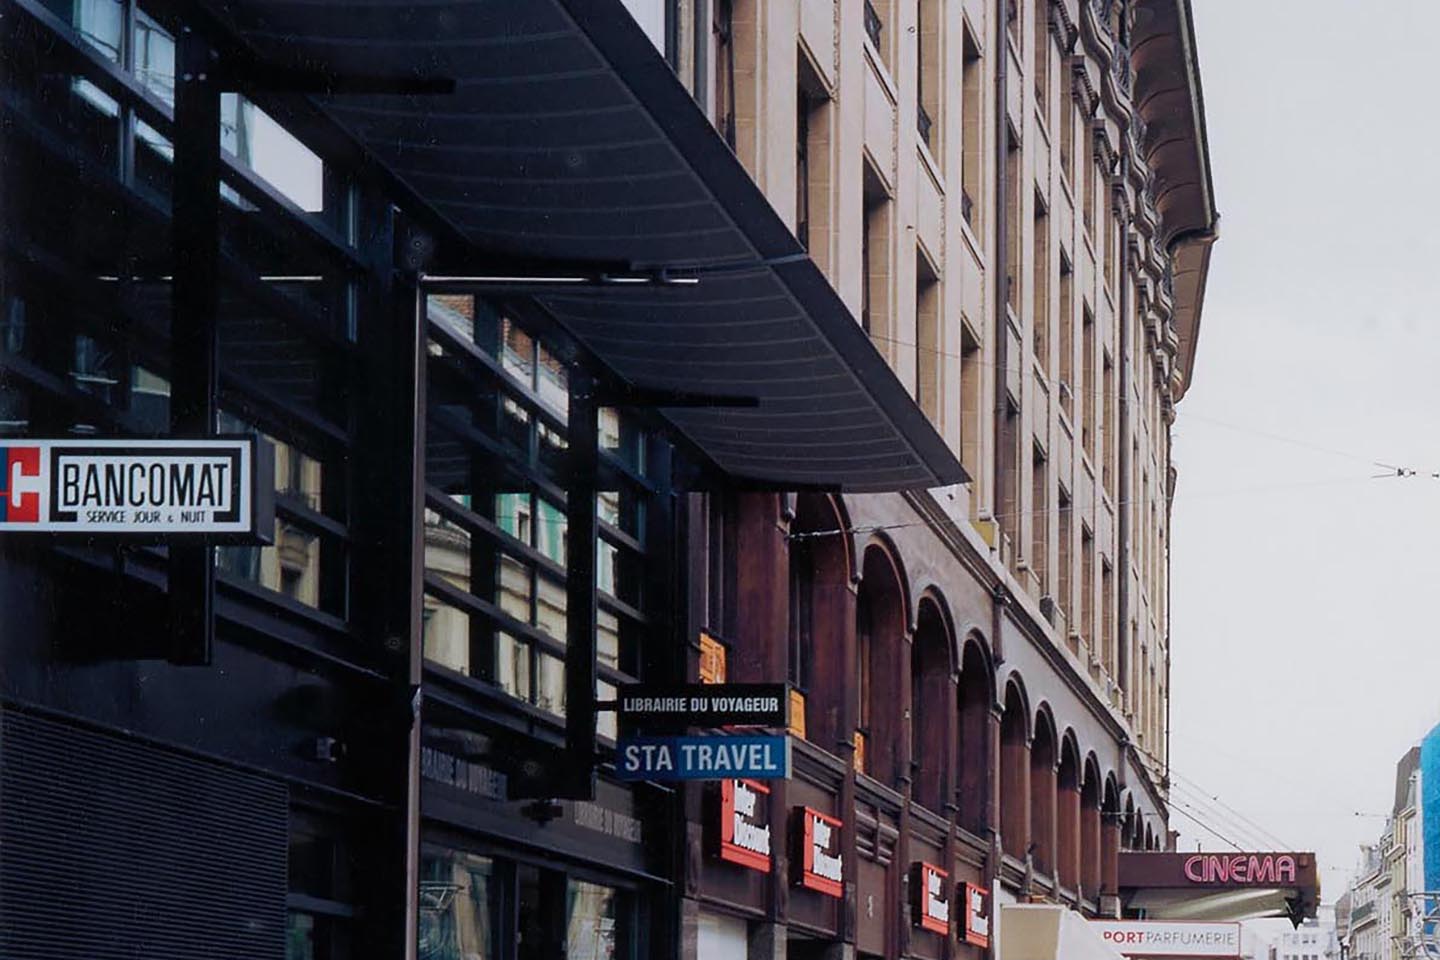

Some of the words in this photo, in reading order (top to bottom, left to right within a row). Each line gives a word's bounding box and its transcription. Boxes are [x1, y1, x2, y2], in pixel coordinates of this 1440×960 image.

[63, 462, 228, 508] BANCOMAT
[86, 511, 126, 523] SERVICE
[132, 511, 162, 523] JOUR
[181, 510, 206, 523] NUIT
[623, 697, 687, 713] LIBRAIRIE
[690, 697, 708, 713] DU
[711, 697, 779, 712] VOYAGEUR
[625, 745, 673, 772] STA
[681, 743, 777, 771] TRAVEL
[1184, 855, 1296, 882] CINEMA
